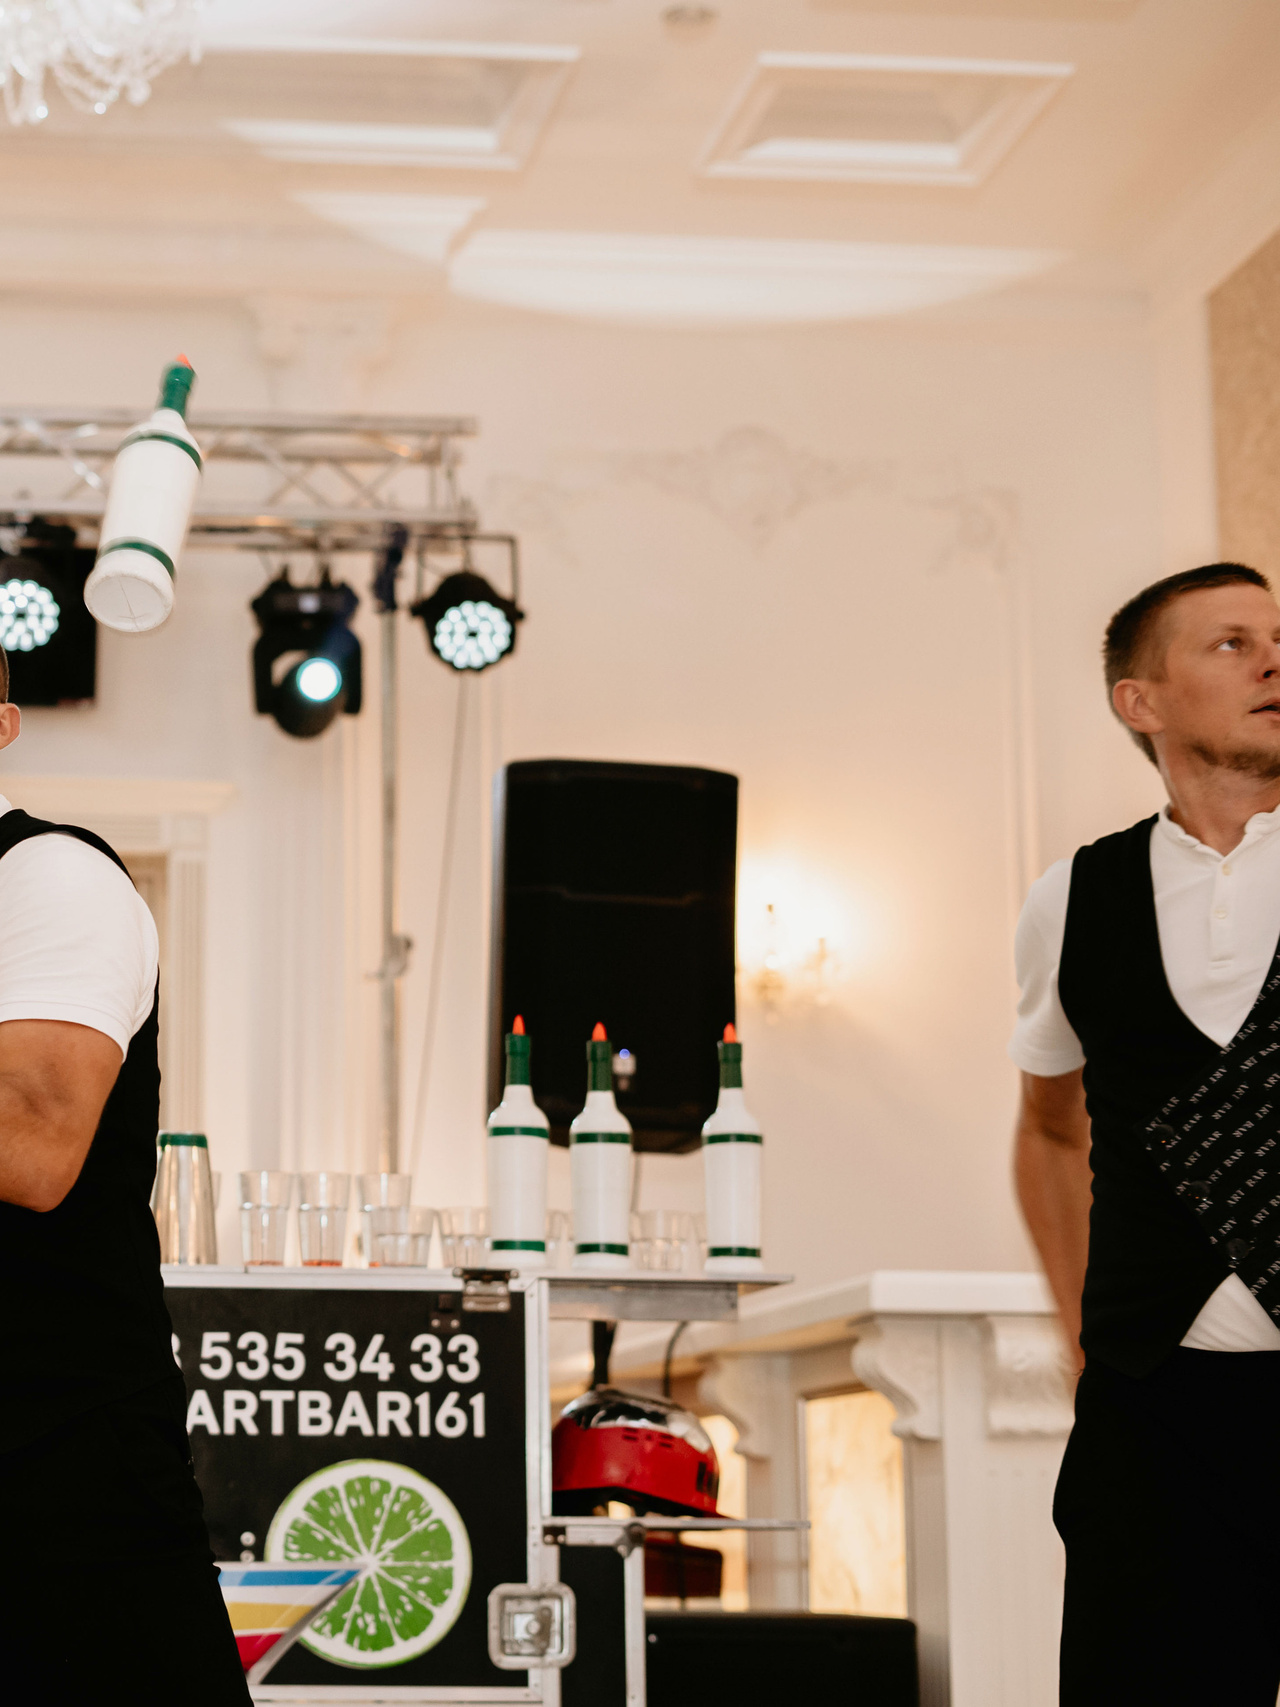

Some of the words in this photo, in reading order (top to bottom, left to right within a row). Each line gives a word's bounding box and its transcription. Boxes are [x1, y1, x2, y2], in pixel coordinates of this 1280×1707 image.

[1240, 1055, 1258, 1072] ART
[1182, 1113, 1203, 1132] BAR
[1184, 1151, 1202, 1169] ART
[1201, 1130, 1223, 1149] BAR
[1222, 1148, 1245, 1168] BAR
[1226, 1188, 1245, 1207] ART
[1244, 1168, 1268, 1188] BAR
[1250, 1206, 1271, 1227] ART
[199, 1331, 306, 1381] 535
[323, 1332, 395, 1382] 34
[410, 1333, 481, 1383] 33
[186, 1389, 486, 1438] ARTBAR161
